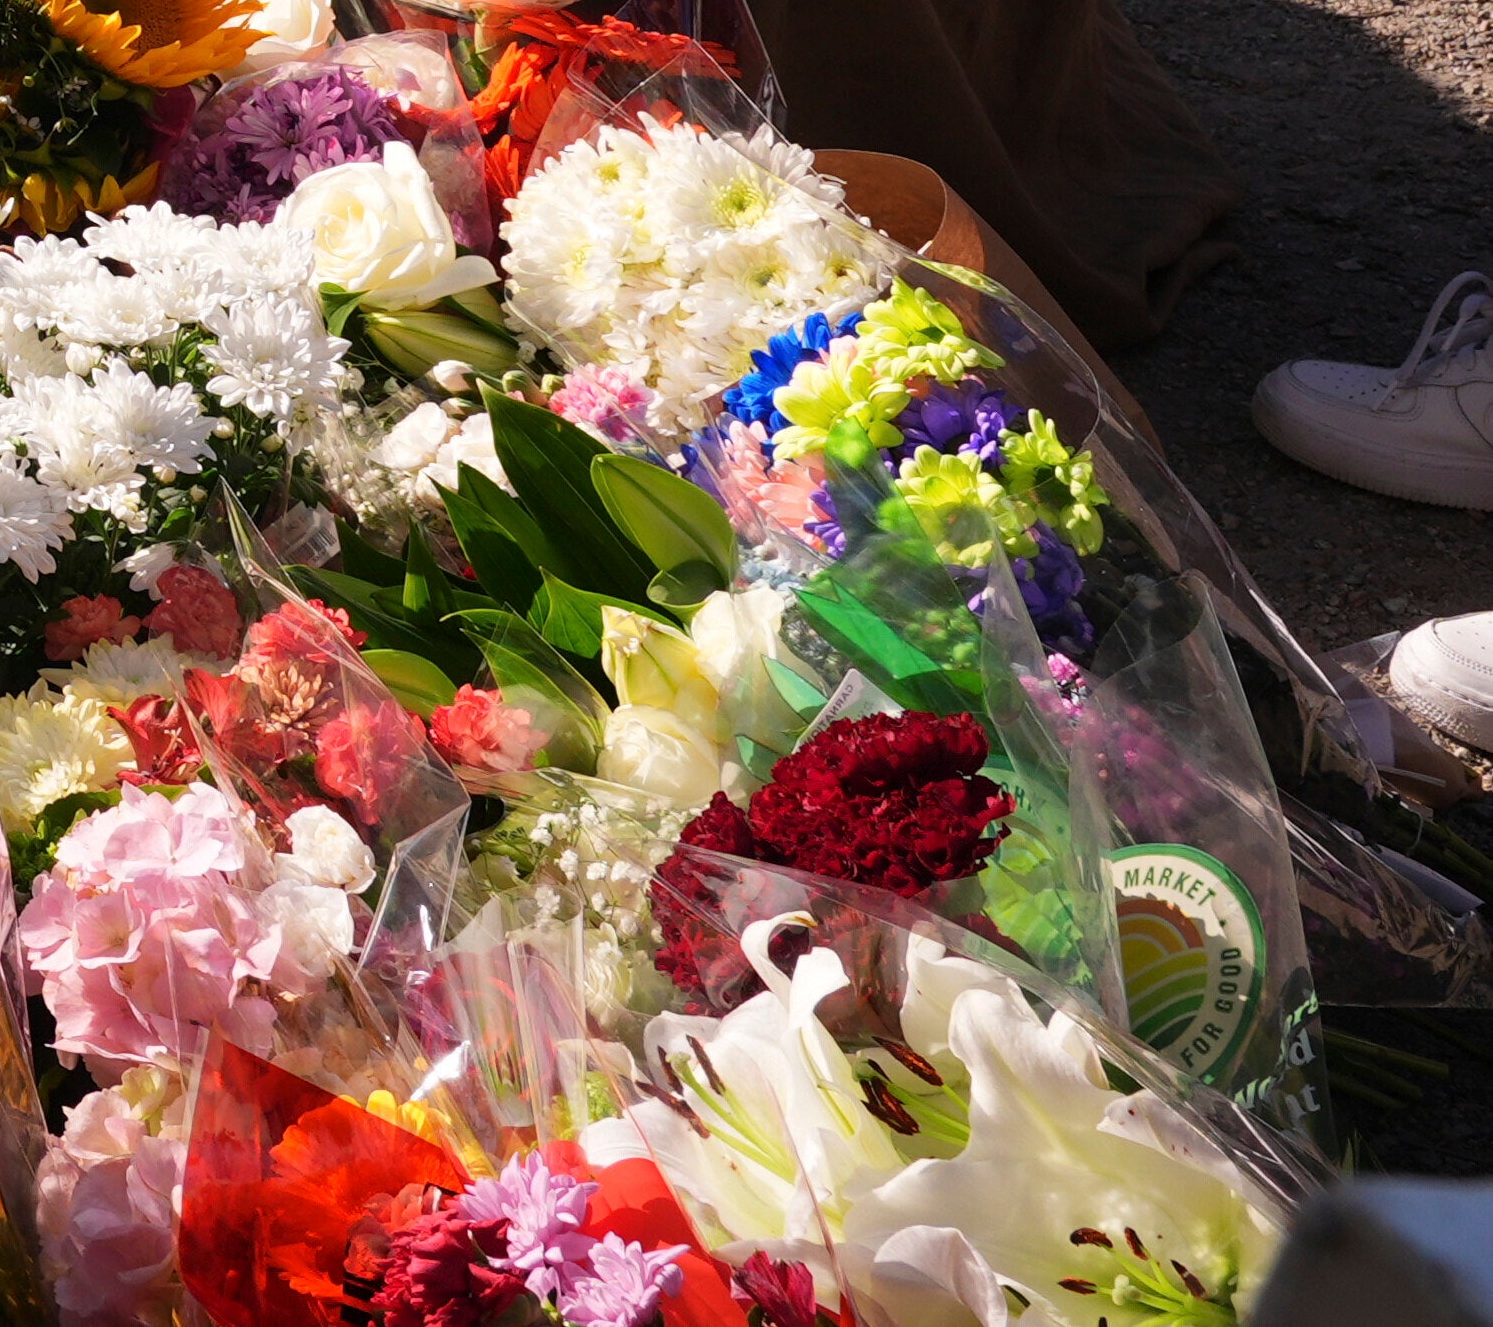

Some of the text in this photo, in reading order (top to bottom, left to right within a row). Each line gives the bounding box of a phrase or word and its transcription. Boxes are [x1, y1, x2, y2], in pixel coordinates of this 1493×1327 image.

[1124, 866, 1216, 907] MARKET
[1180, 947, 1242, 1069] FOR GOOD
